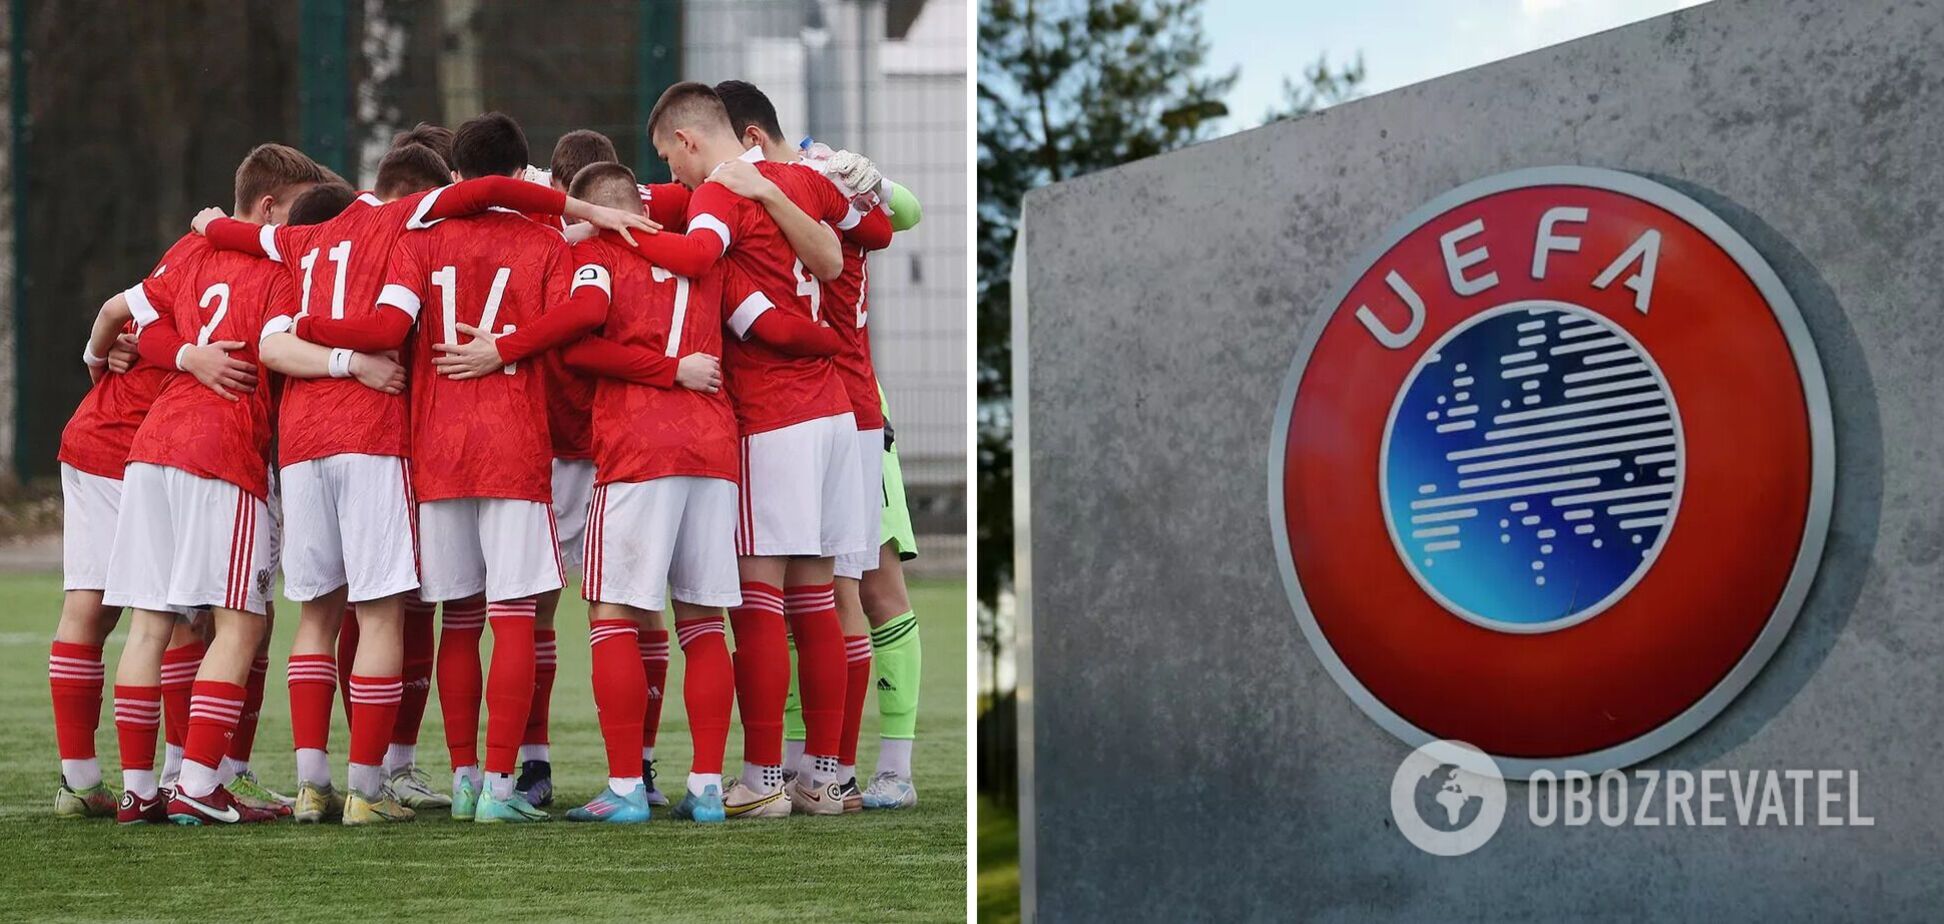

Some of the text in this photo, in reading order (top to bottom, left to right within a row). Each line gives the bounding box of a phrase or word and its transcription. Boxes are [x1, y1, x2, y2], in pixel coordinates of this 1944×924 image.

[197, 282, 230, 354] 2
[301, 240, 352, 320] 11
[431, 265, 517, 375] 14
[651, 266, 689, 358] 7
[1355, 206, 1661, 349] UEFA
